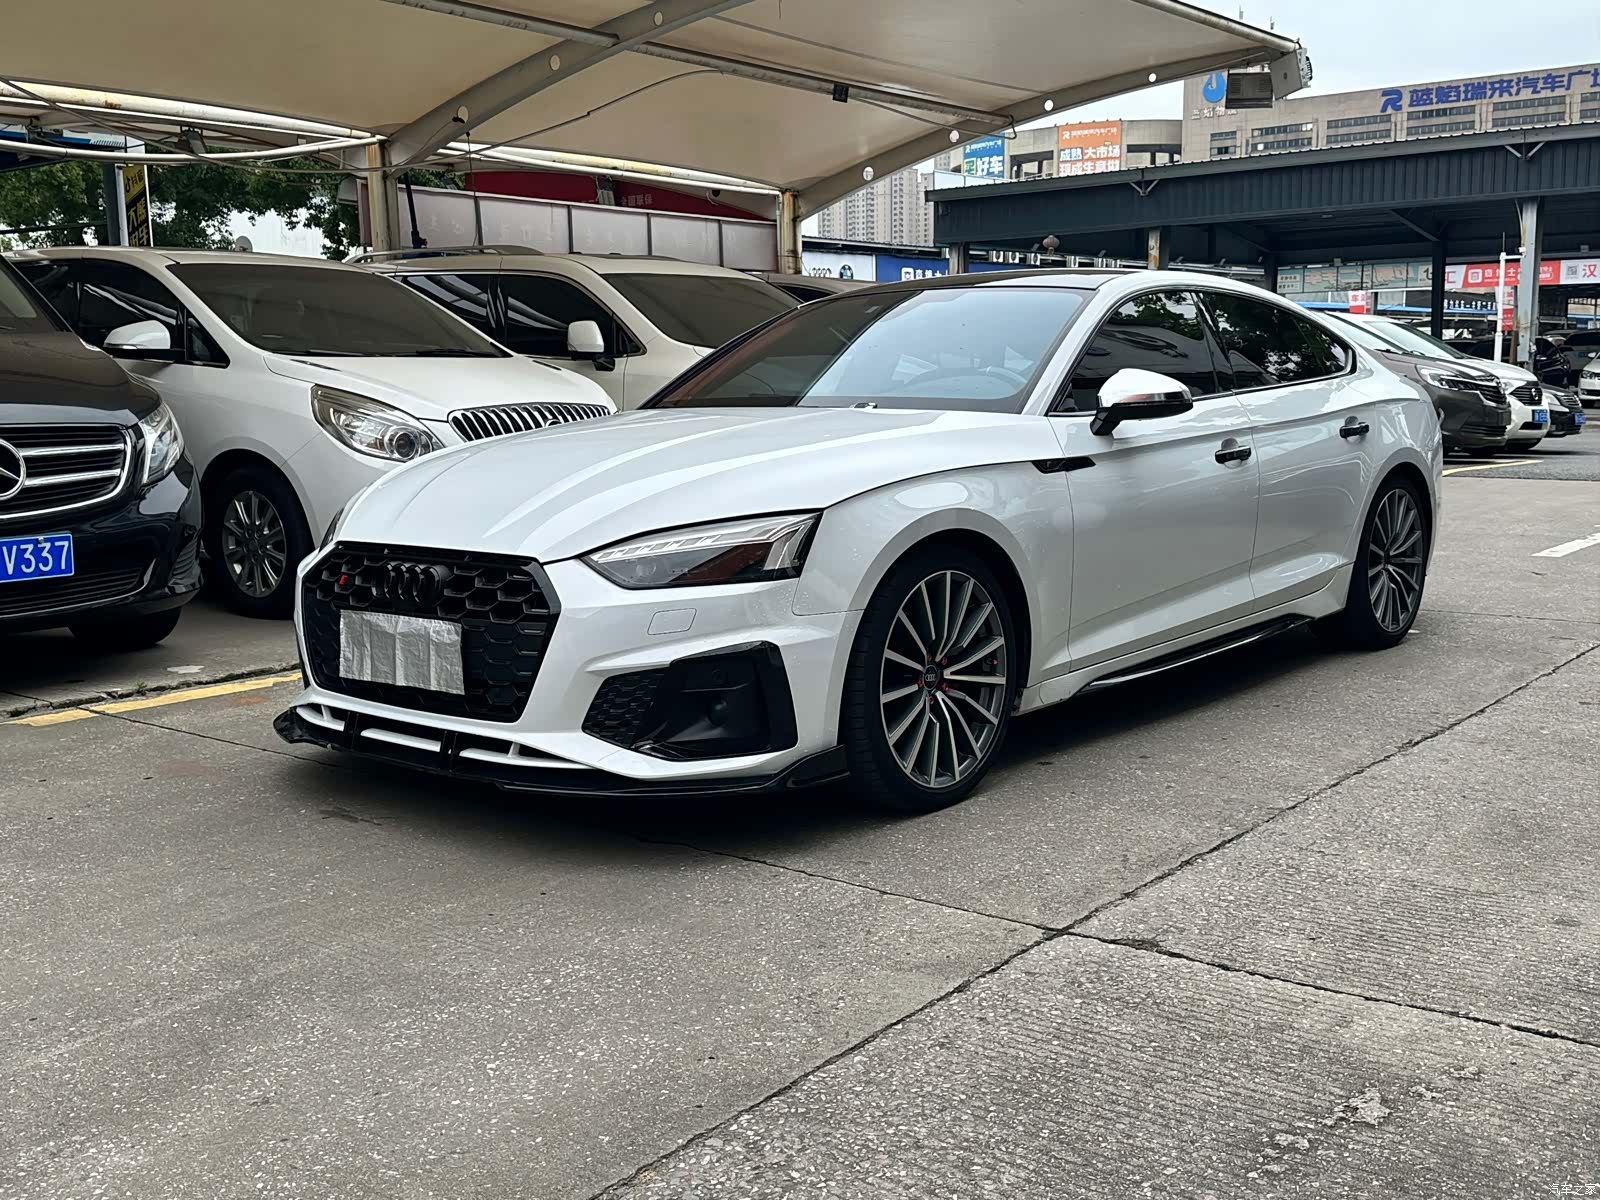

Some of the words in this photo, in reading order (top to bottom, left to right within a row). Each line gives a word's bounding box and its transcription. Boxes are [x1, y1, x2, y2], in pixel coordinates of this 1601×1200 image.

[1084, 144, 1120, 159] 大市场
[1582, 263, 1597, 278] 汉
[2, 540, 69, 575] V337
